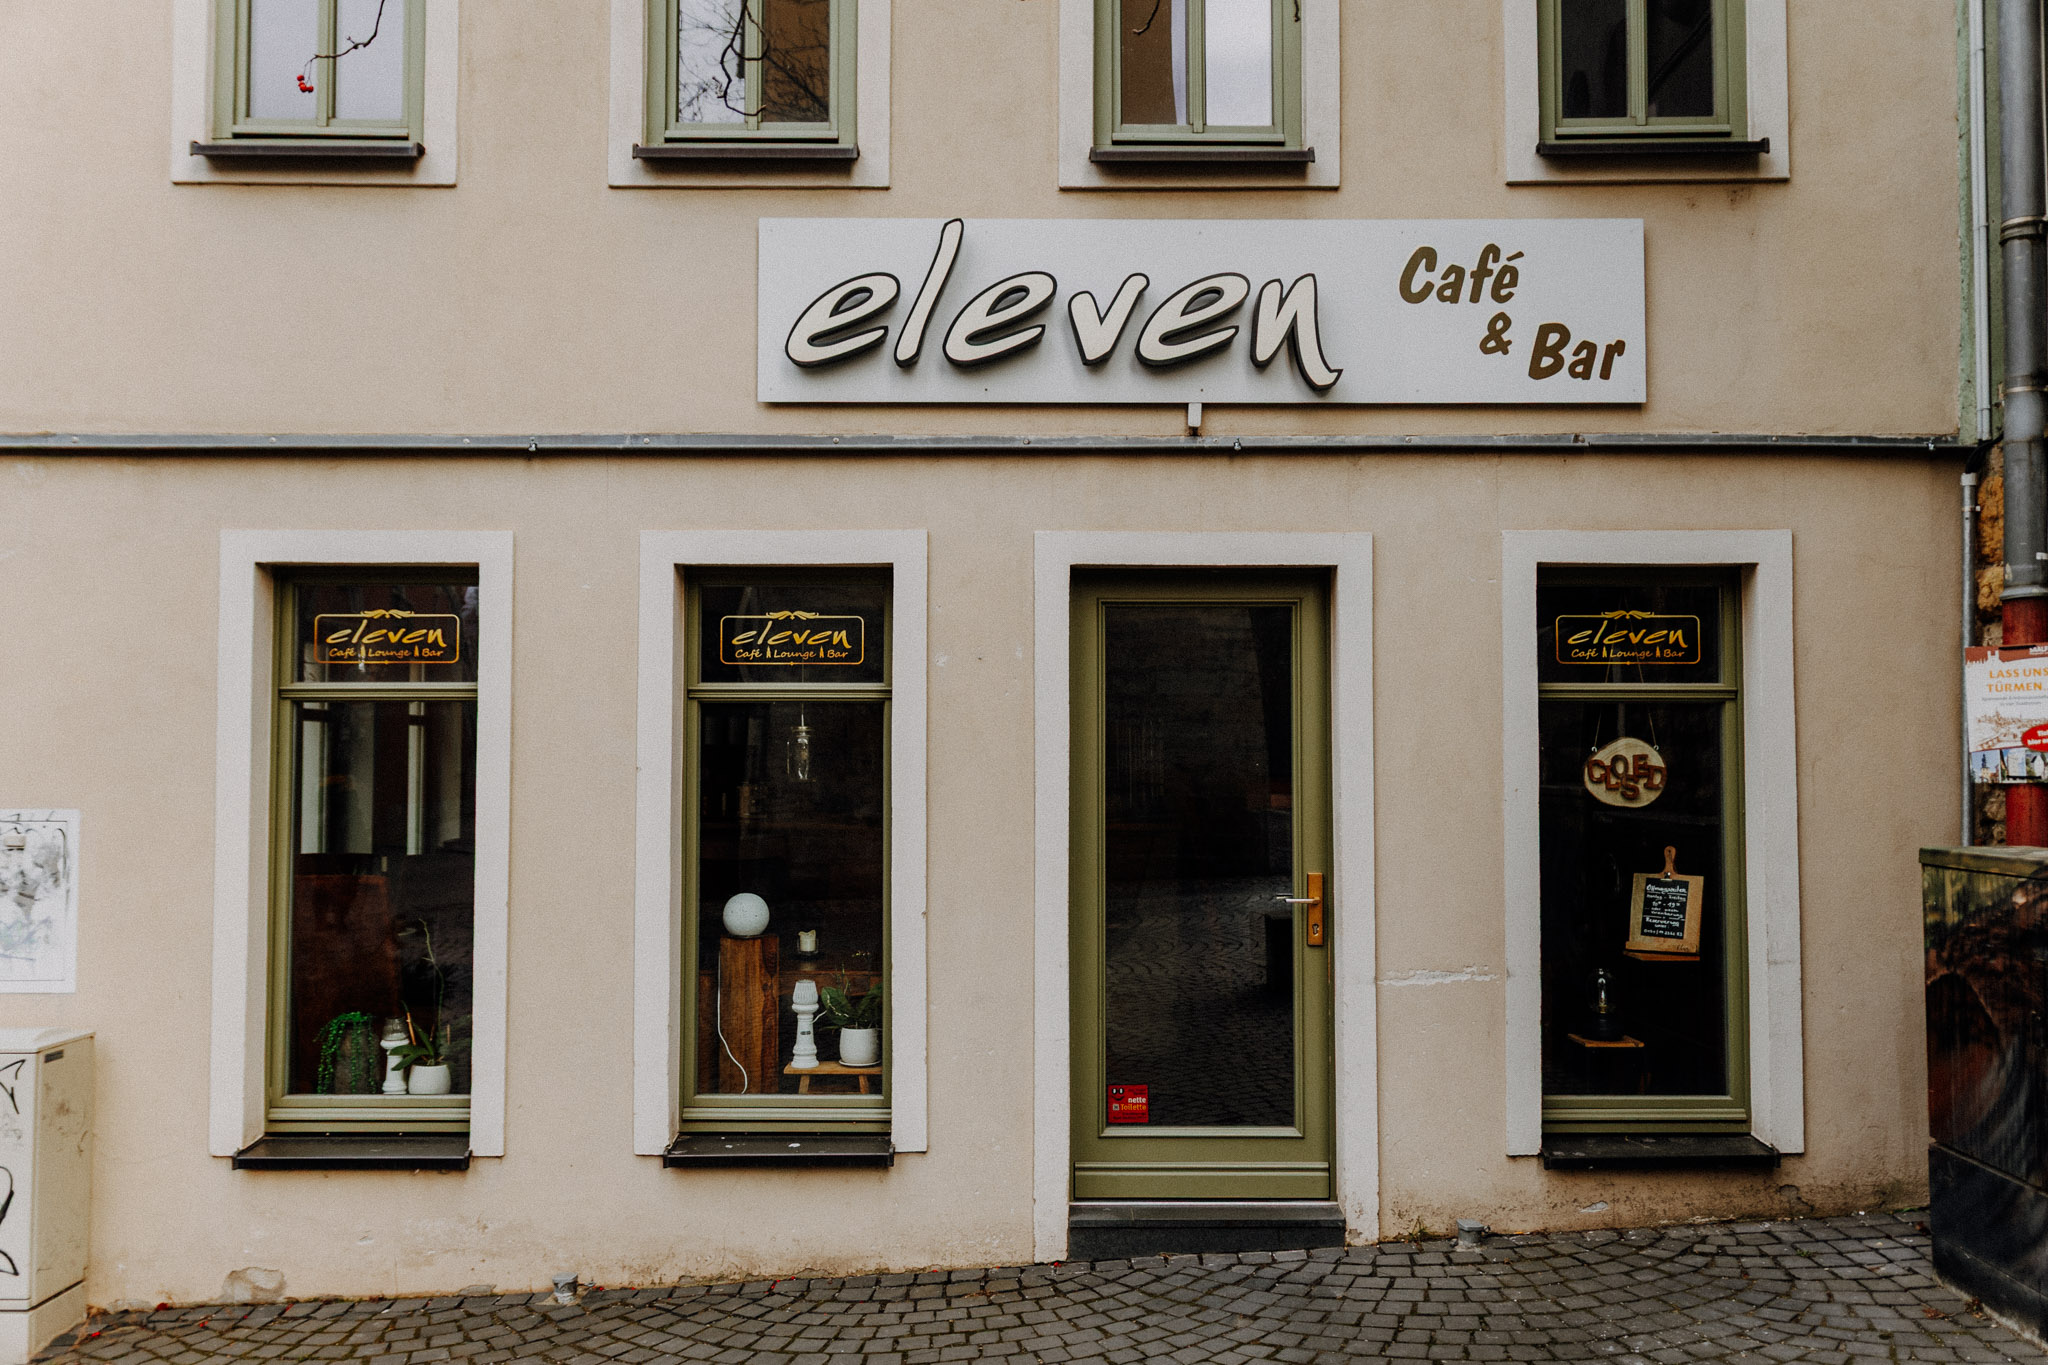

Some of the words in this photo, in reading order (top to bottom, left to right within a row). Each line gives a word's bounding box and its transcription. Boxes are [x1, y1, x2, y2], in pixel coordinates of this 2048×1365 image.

[1399, 243, 1525, 304] Café
[785, 218, 1343, 391] eleven
[1479, 311, 1512, 355] &
[1528, 322, 1626, 380] Bar
[325, 619, 447, 648] eleven
[731, 620, 852, 649] eleven
[1567, 620, 1688, 648] eleven
[329, 648, 355, 659] Café
[367, 648, 411, 659] Lounge
[421, 648, 444, 657] Bar
[735, 648, 762, 660] Café
[773, 649, 816, 660] Lounge
[826, 649, 849, 658] Bar
[1571, 648, 1598, 660] Café
[1610, 648, 1653, 660] Lounge
[1663, 649, 1685, 657] Bar
[1989, 669, 2019, 679] LASS
[1587, 754, 1666, 800] CLOSED
